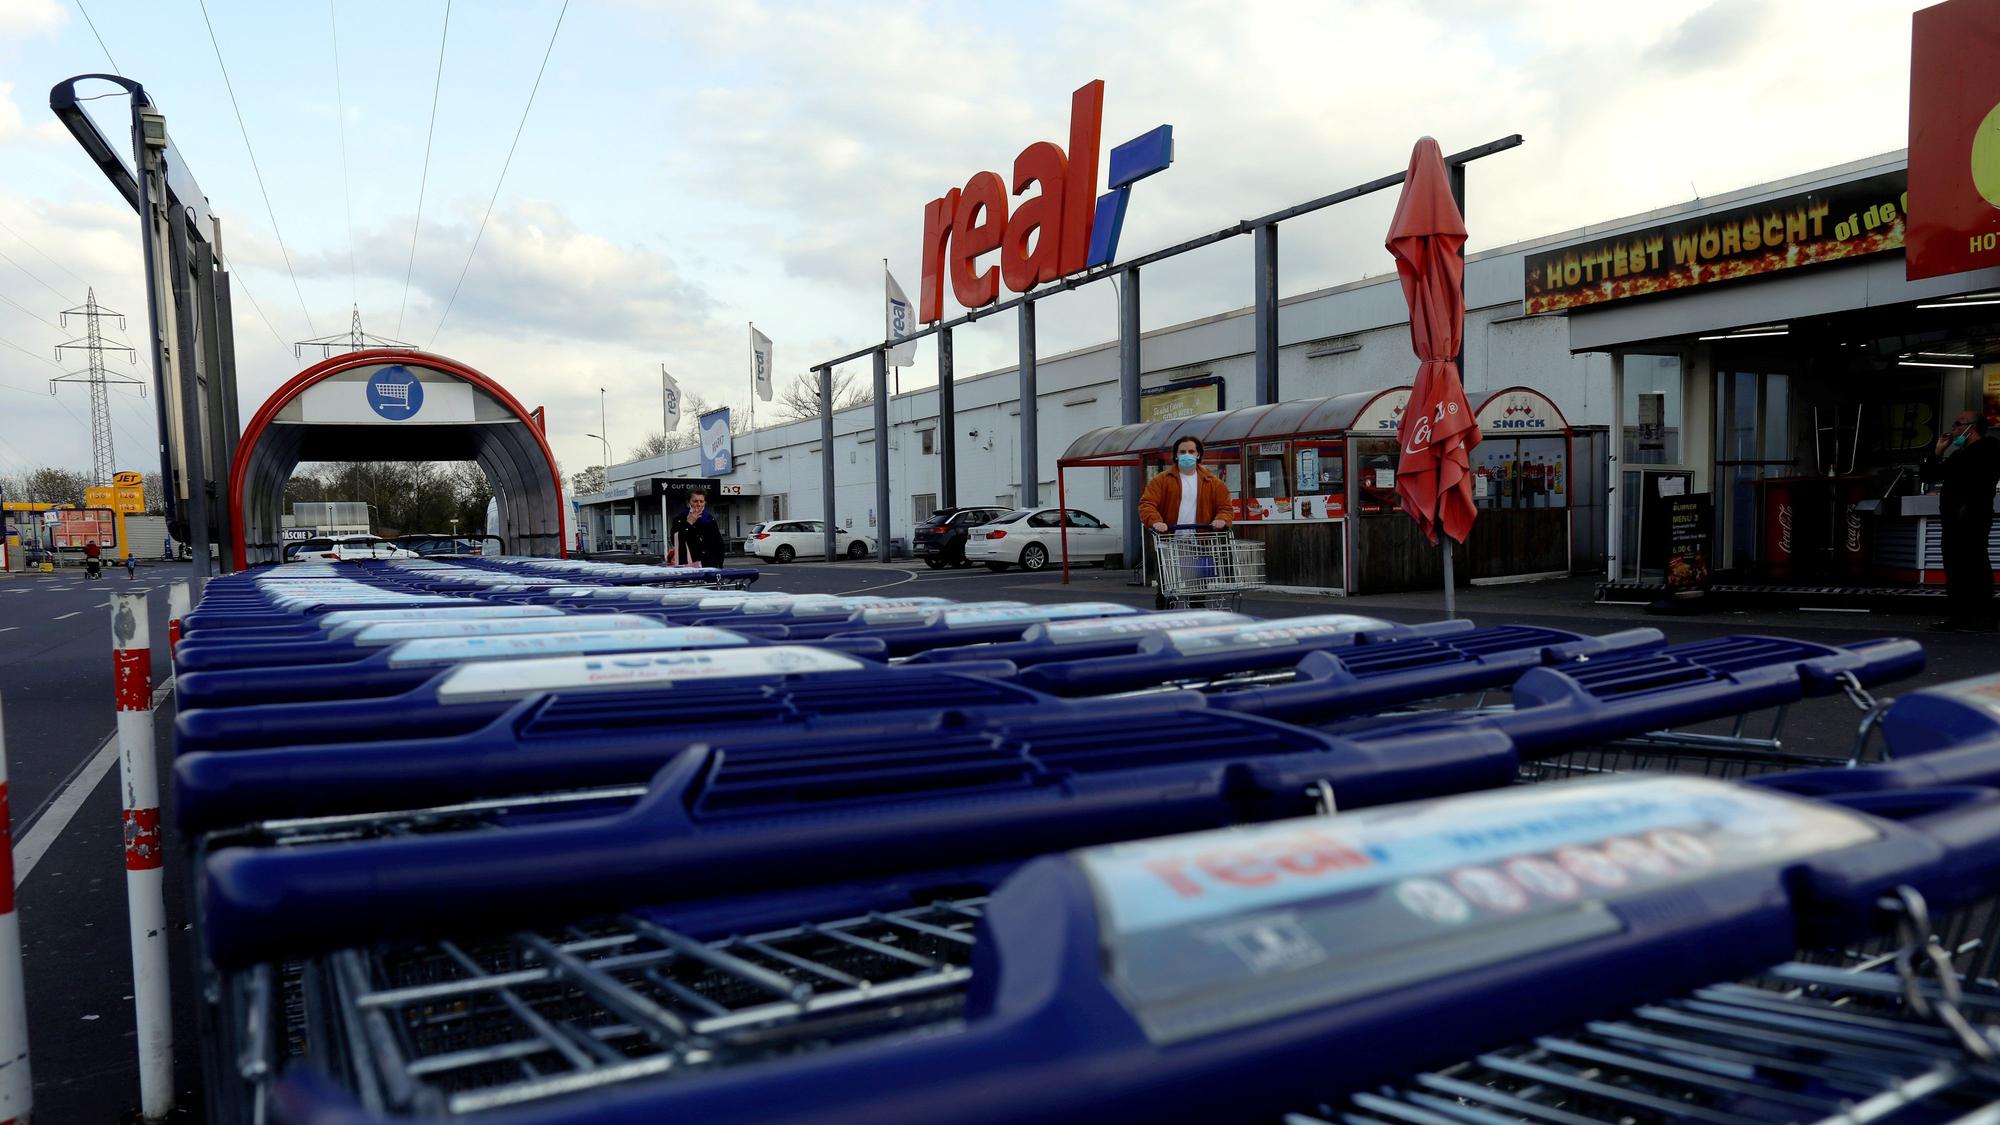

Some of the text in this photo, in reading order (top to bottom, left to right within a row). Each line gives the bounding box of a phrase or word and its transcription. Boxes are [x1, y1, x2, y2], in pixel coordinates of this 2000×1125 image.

[1547, 233, 1664, 289] HOTTEST
[1672, 200, 1829, 265] WORSCHT
[1834, 213, 1859, 242] of
[1863, 202, 1896, 231] de
[665, 388, 677, 415] real
[1492, 419, 1545, 428] SNACK
[117, 474, 139, 482] JET
